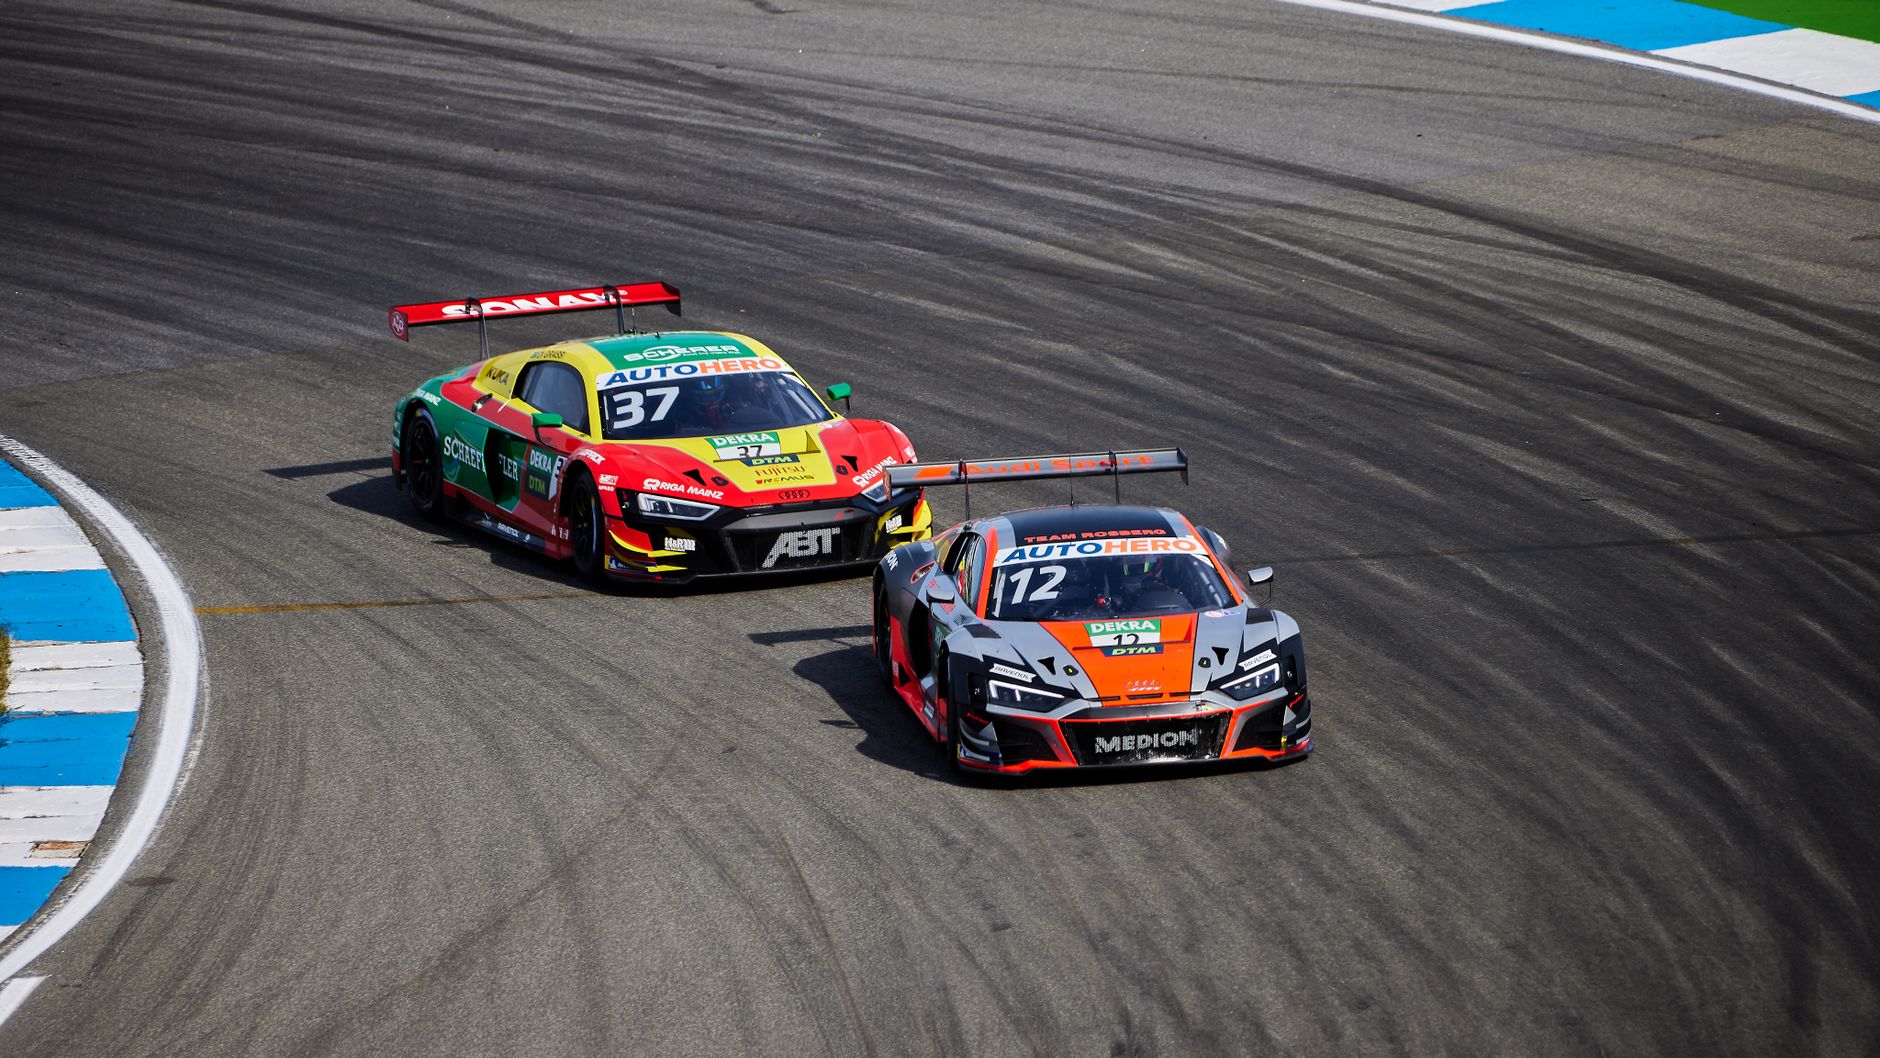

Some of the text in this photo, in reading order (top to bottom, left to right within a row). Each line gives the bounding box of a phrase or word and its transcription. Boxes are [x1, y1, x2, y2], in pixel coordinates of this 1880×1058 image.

[624, 345, 740, 361] SCHERER
[605, 358, 782, 387] AUTOHERO
[613, 387, 680, 429] 37
[712, 432, 775, 447] DEKRA
[737, 445, 763, 459] 37
[530, 449, 552, 474] DEKRA
[752, 456, 793, 466] DTM
[755, 465, 806, 476] FUJITSU
[528, 475, 546, 495] DTM
[660, 481, 724, 499] RIGA MAINZ
[1024, 529, 1166, 543] TEAM ROSBERG
[762, 528, 832, 568] ABT
[1001, 539, 1197, 563] AUTOHERO
[1009, 565, 1067, 605] 12
[1090, 620, 1156, 633] DEKRA
[1113, 633, 1140, 646] 12
[1111, 646, 1156, 656] DTM
[994, 666, 1030, 680] RAVENOL
[1095, 728, 1199, 753] MEDION
